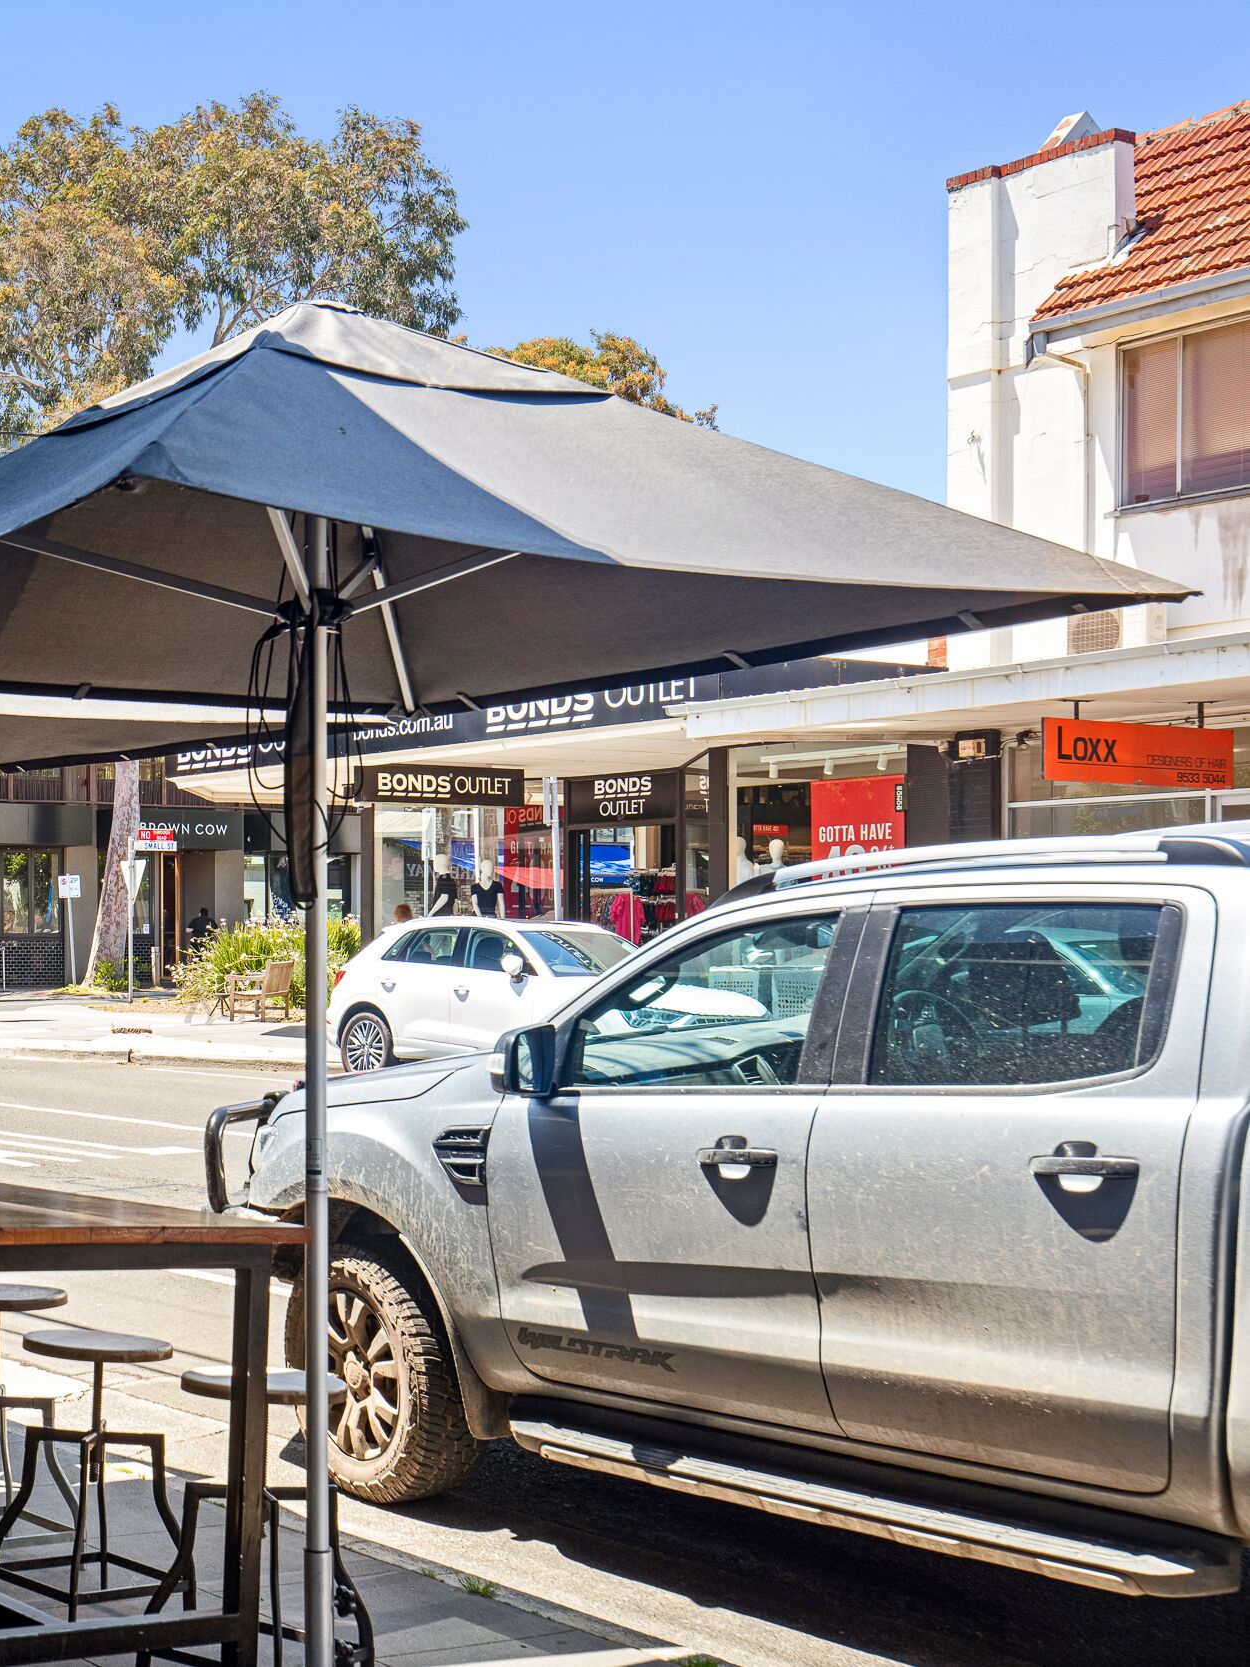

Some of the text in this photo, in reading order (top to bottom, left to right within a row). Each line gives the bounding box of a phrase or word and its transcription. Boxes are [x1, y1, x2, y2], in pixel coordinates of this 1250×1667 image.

[1146, 754, 1227, 769] DESIGNERS OF HAIR
[377, 772, 512, 796] BONDS OUTLET
[594, 776, 652, 794] BONDS
[1176, 772, 1226, 785] 9533 5044
[599, 799, 646, 817] OUTLET
[140, 830, 151, 840] NO
[194, 823, 228, 836] COW
[818, 822, 893, 843] GOTTA HAVE
[144, 842, 175, 850] SMALL ST
[516, 1326, 677, 1374] WILDTRAK
